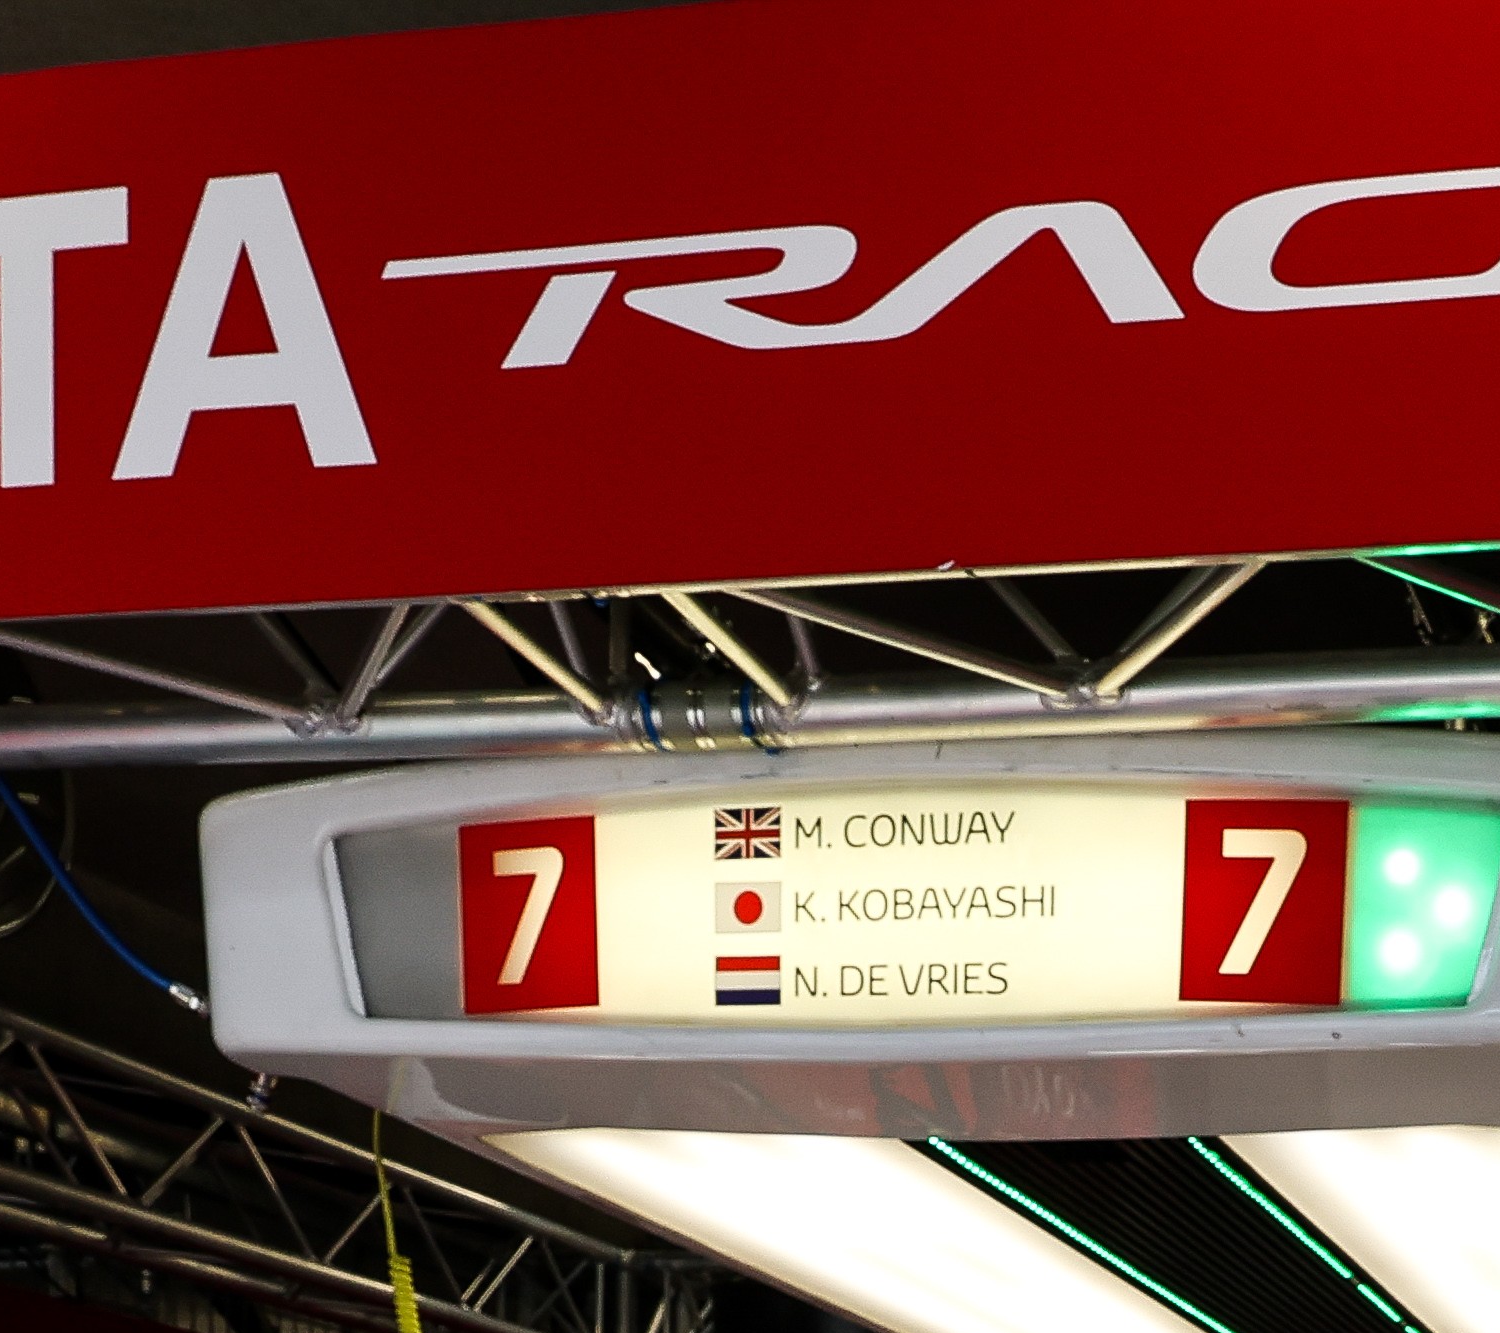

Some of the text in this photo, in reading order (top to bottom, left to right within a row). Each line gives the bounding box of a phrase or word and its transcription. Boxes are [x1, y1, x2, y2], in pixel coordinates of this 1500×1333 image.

[793, 811, 1016, 849] M. CONWAY
[489, 846, 566, 989] 7
[793, 885, 1056, 923] K. KOBAYASHI
[1218, 825, 1310, 976] 7
[794, 962, 1009, 998] N. DE VRIES
